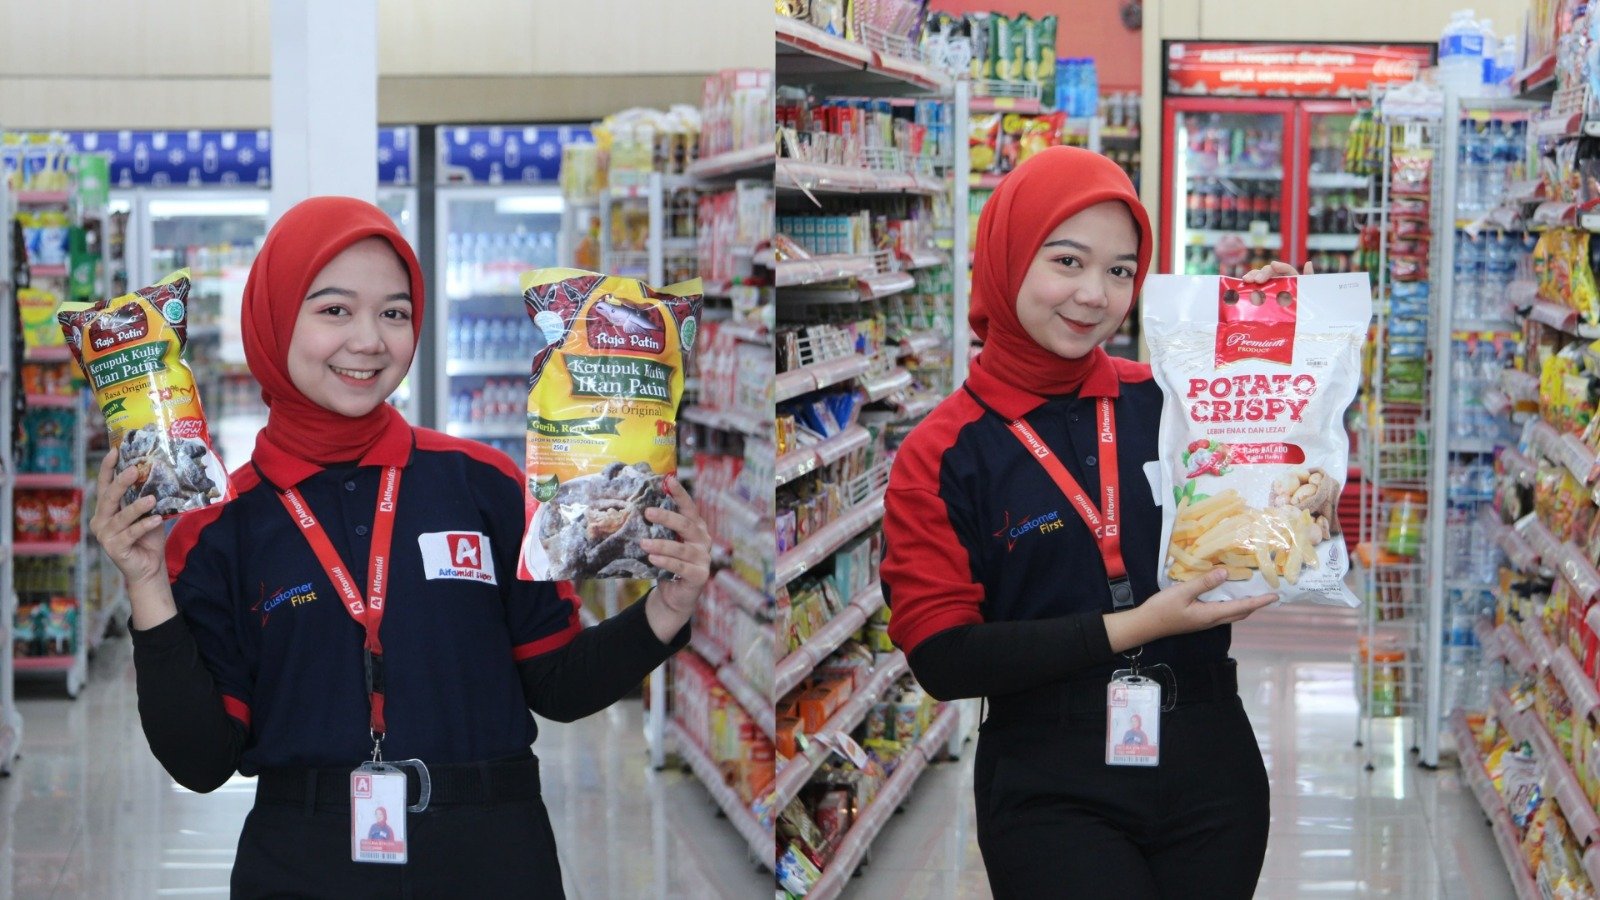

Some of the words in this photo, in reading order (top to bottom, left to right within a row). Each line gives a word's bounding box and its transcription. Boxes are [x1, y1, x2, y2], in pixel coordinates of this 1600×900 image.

[95, 336, 114, 348] Raja
[117, 328, 142, 341] Patin
[595, 332, 625, 347] Raja
[629, 334, 659, 349] Patin
[1226, 333, 1287, 347] Premium
[90, 353, 129, 375] Kerupuk
[131, 345, 161, 362] Kulit
[573, 359, 640, 377] Kerupuk
[95, 372, 119, 388] Ikan
[122, 361, 159, 377] Patin
[105, 391, 121, 400] Rasa
[122, 381, 152, 394] Origina
[578, 376, 621, 392] Ikan
[629, 379, 667, 397] Patin
[1187, 374, 1317, 399] POTATO
[621, 405, 662, 417] Original
[1102, 403, 1111, 434] Alfamidi
[1190, 398, 1309, 423] CRISPY
[172, 420, 202, 429] UKM
[532, 420, 559, 433] Gurih,
[1261, 446, 1288, 454] BALADO
[384, 470, 395, 503] Alfamidi
[286, 493, 308, 519] Alfamidi
[1074, 494, 1100, 525] Alfamidi
[1010, 510, 1059, 538] Customer
[1039, 519, 1064, 535] First
[456, 538, 478, 566] A
[332, 567, 355, 600] Alfamidi
[373, 556, 384, 594] Alfamidi
[439, 567, 474, 578] Alfamidi
[264, 581, 313, 612] Customer
[290, 591, 317, 607] First
